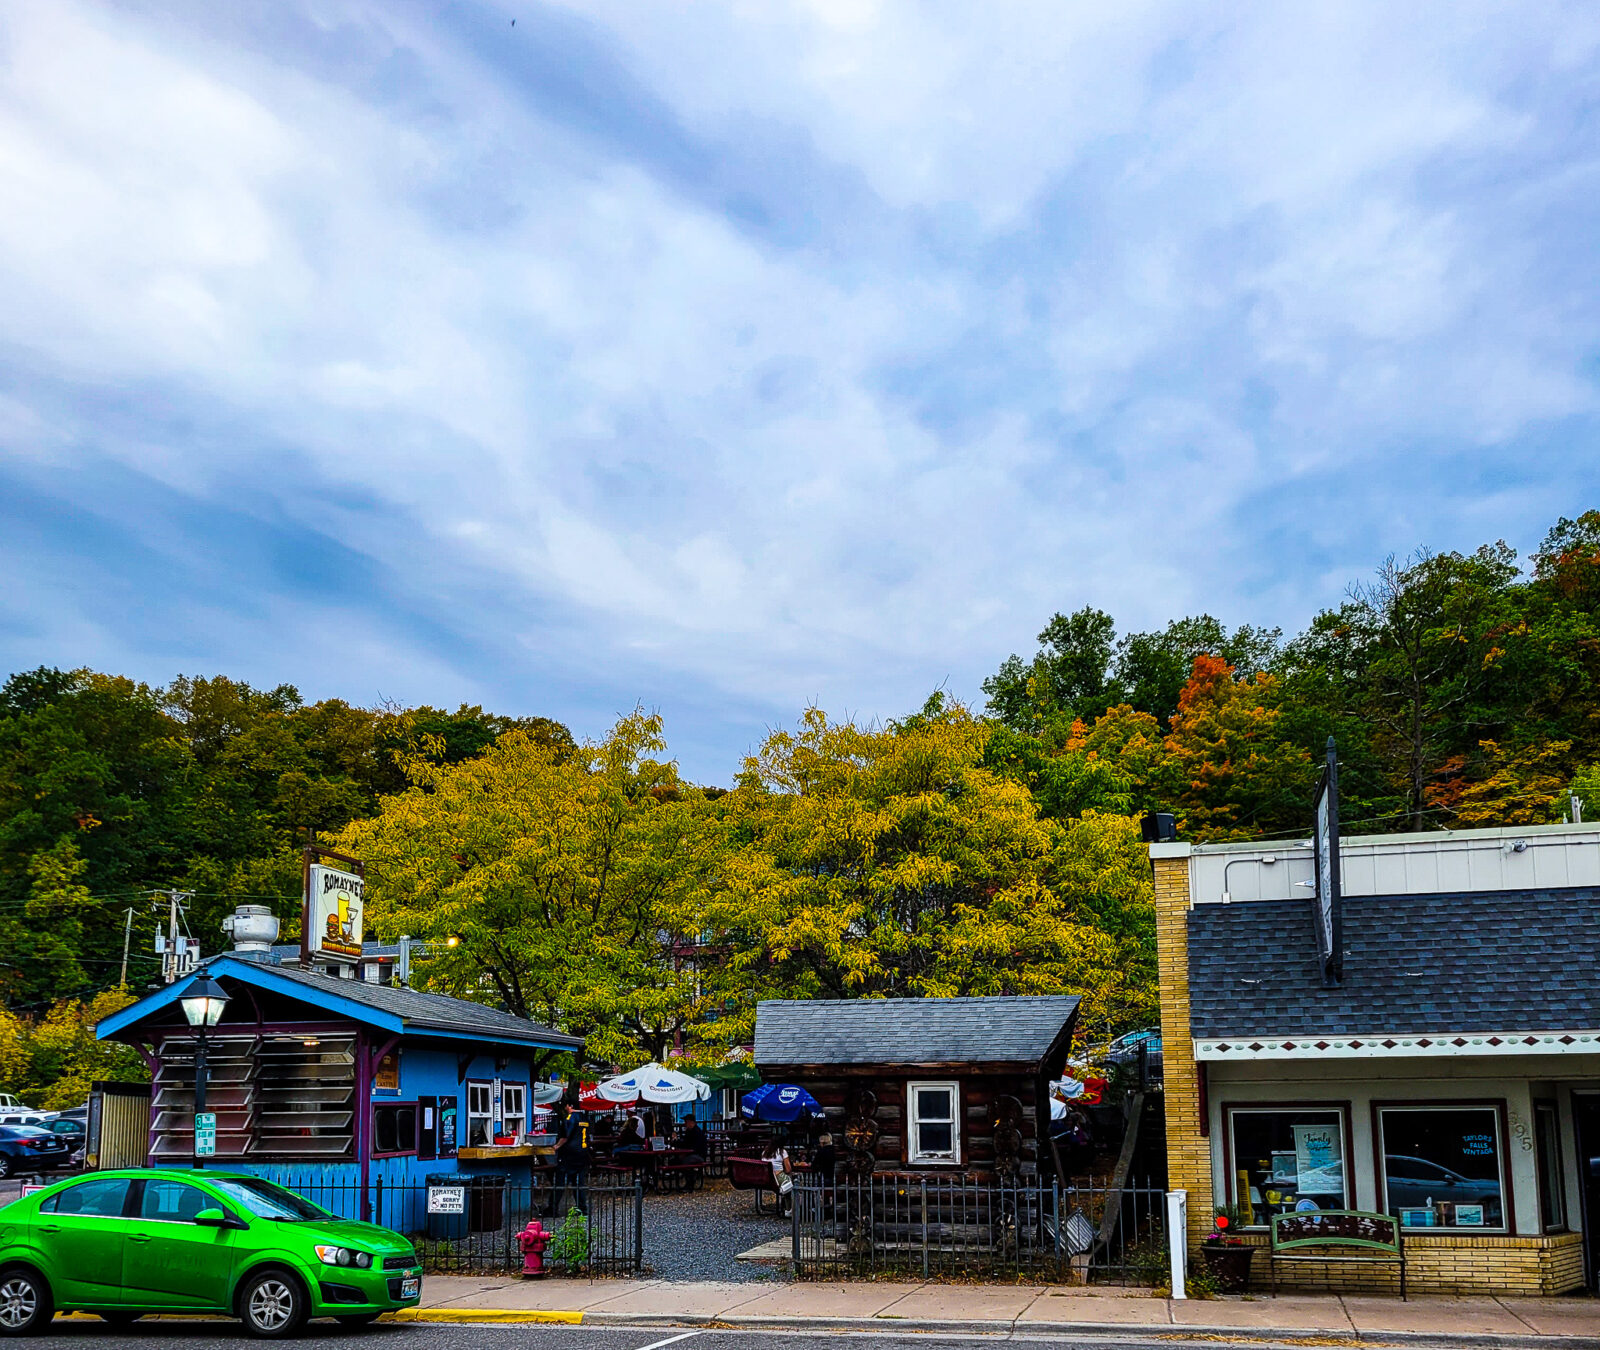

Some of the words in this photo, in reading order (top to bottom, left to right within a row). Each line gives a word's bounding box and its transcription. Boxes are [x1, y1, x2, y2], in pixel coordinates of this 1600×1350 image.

[324, 873, 364, 902] ROMAYNE'S
[197, 1117, 202, 1128] 3
[1462, 1147, 1494, 1155] VINTAGE
[432, 1188, 461, 1198] ROMAYNE'S
